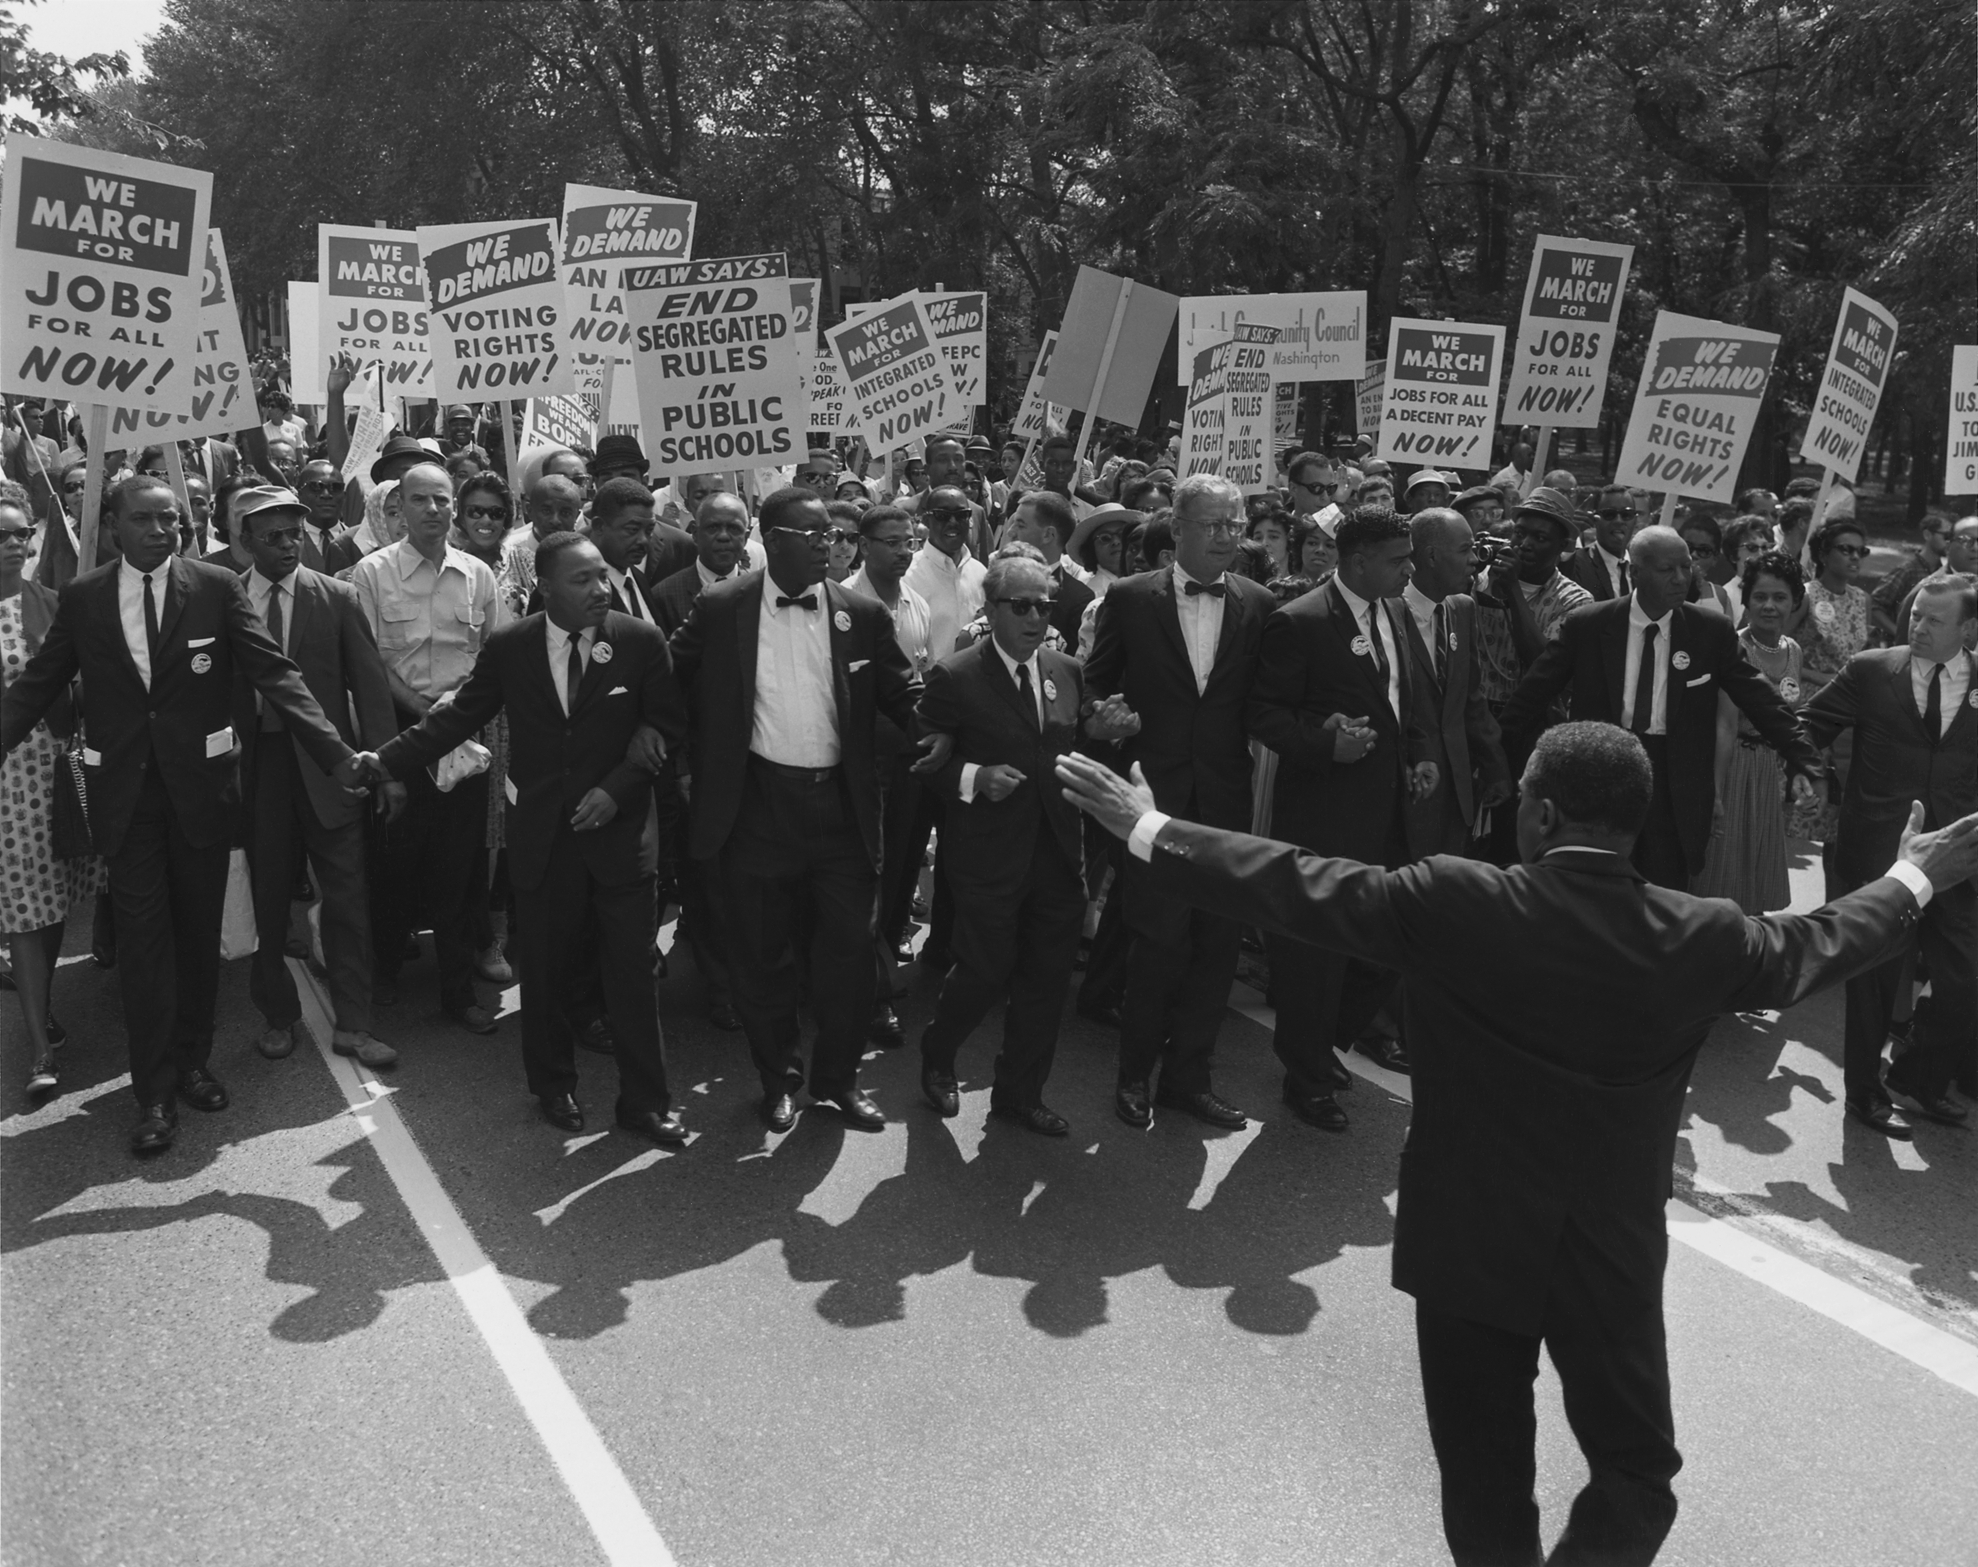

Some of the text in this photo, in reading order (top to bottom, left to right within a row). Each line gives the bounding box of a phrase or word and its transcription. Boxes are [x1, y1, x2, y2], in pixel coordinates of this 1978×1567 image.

[85, 176, 136, 207] WE
[31, 196, 180, 250] MARCH
[606, 207, 652, 230] WE
[78, 240, 134, 262] FOR
[369, 244, 402, 262] WE
[466, 234, 510, 267] WE
[572, 228, 682, 258] DEMAND
[438, 252, 549, 303] DEMAND
[568, 267, 606, 288] AN
[633, 266, 692, 288] UAW
[698, 258, 780, 282] SAYS:
[1572, 258, 1594, 277] WE
[26, 270, 172, 323] JOBS
[368, 286, 404, 297] FOR
[1540, 277, 1612, 304] MARCH
[590, 293, 624, 314] LA
[657, 288, 758, 319] END
[930, 300, 958, 320] WE
[1560, 305, 1586, 317] FOR
[338, 308, 428, 336] JOBS
[442, 306, 557, 332] VOTING
[570, 317, 632, 344] NO
[862, 318, 889, 338] WE
[933, 312, 979, 334] MAND
[1315, 306, 1360, 342] Council
[1868, 316, 1882, 336] WE
[28, 314, 164, 348] FOR ALL
[637, 313, 786, 352] SEGREGATED
[1432, 335, 1460, 350] WE
[340, 338, 427, 352] FOR ALL
[454, 332, 554, 358] RIGHTS
[848, 322, 918, 366] MARCH
[942, 346, 980, 360] FEPC
[1530, 330, 1600, 360] JOBS
[1694, 341, 1740, 364] WE
[1843, 328, 1886, 370] MARCH
[661, 346, 768, 378] RULES
[820, 362, 837, 372] One
[874, 350, 901, 366] FOR
[1211, 344, 1231, 370] WE
[1234, 348, 1265, 368] END
[1402, 350, 1485, 372] MARCH
[1854, 358, 1870, 376] FOR
[19, 346, 174, 394] NOW!
[458, 353, 558, 390] NOW!
[854, 352, 935, 400] INTEGRATED
[1427, 371, 1458, 382] FOR
[1529, 364, 1591, 377] FOR ALL
[1656, 366, 1764, 390] DEMAND
[584, 378, 604, 388] FO
[698, 383, 736, 400] IN
[811, 386, 840, 401] PEAK
[1226, 372, 1270, 393] SEGREGATED
[1828, 368, 1876, 411] INTEGRATED
[827, 402, 842, 410] FO
[862, 374, 943, 420] SCHOOLS
[1030, 402, 1042, 410] FO
[1232, 397, 1262, 416] RULES
[1374, 394, 1382, 402] EN
[1390, 388, 1488, 408] JOBS FOR ALL
[1518, 385, 1594, 413] NOW!
[662, 397, 782, 432] PUBLIC
[880, 392, 945, 444] NOW!
[1192, 410, 1224, 428] VOTIN
[1362, 406, 1371, 414] TO
[1386, 408, 1486, 428] A DECENT PAY
[1656, 399, 1736, 436] EQUAL
[1820, 396, 1868, 436] SCHOOLS
[548, 408, 582, 438] WE ARE
[1240, 425, 1251, 436] IN
[660, 428, 792, 464] SCHOOLS
[1191, 434, 1222, 452] RIGHT
[1229, 438, 1262, 460] PUBLIC
[1393, 432, 1479, 456] NOW!
[1648, 424, 1734, 460] RIGHTS
[1814, 426, 1860, 465] NOW!
[1187, 456, 1221, 478] NOW
[1226, 464, 1262, 485] SCHOOLS
[1637, 452, 1729, 490] NOW!
